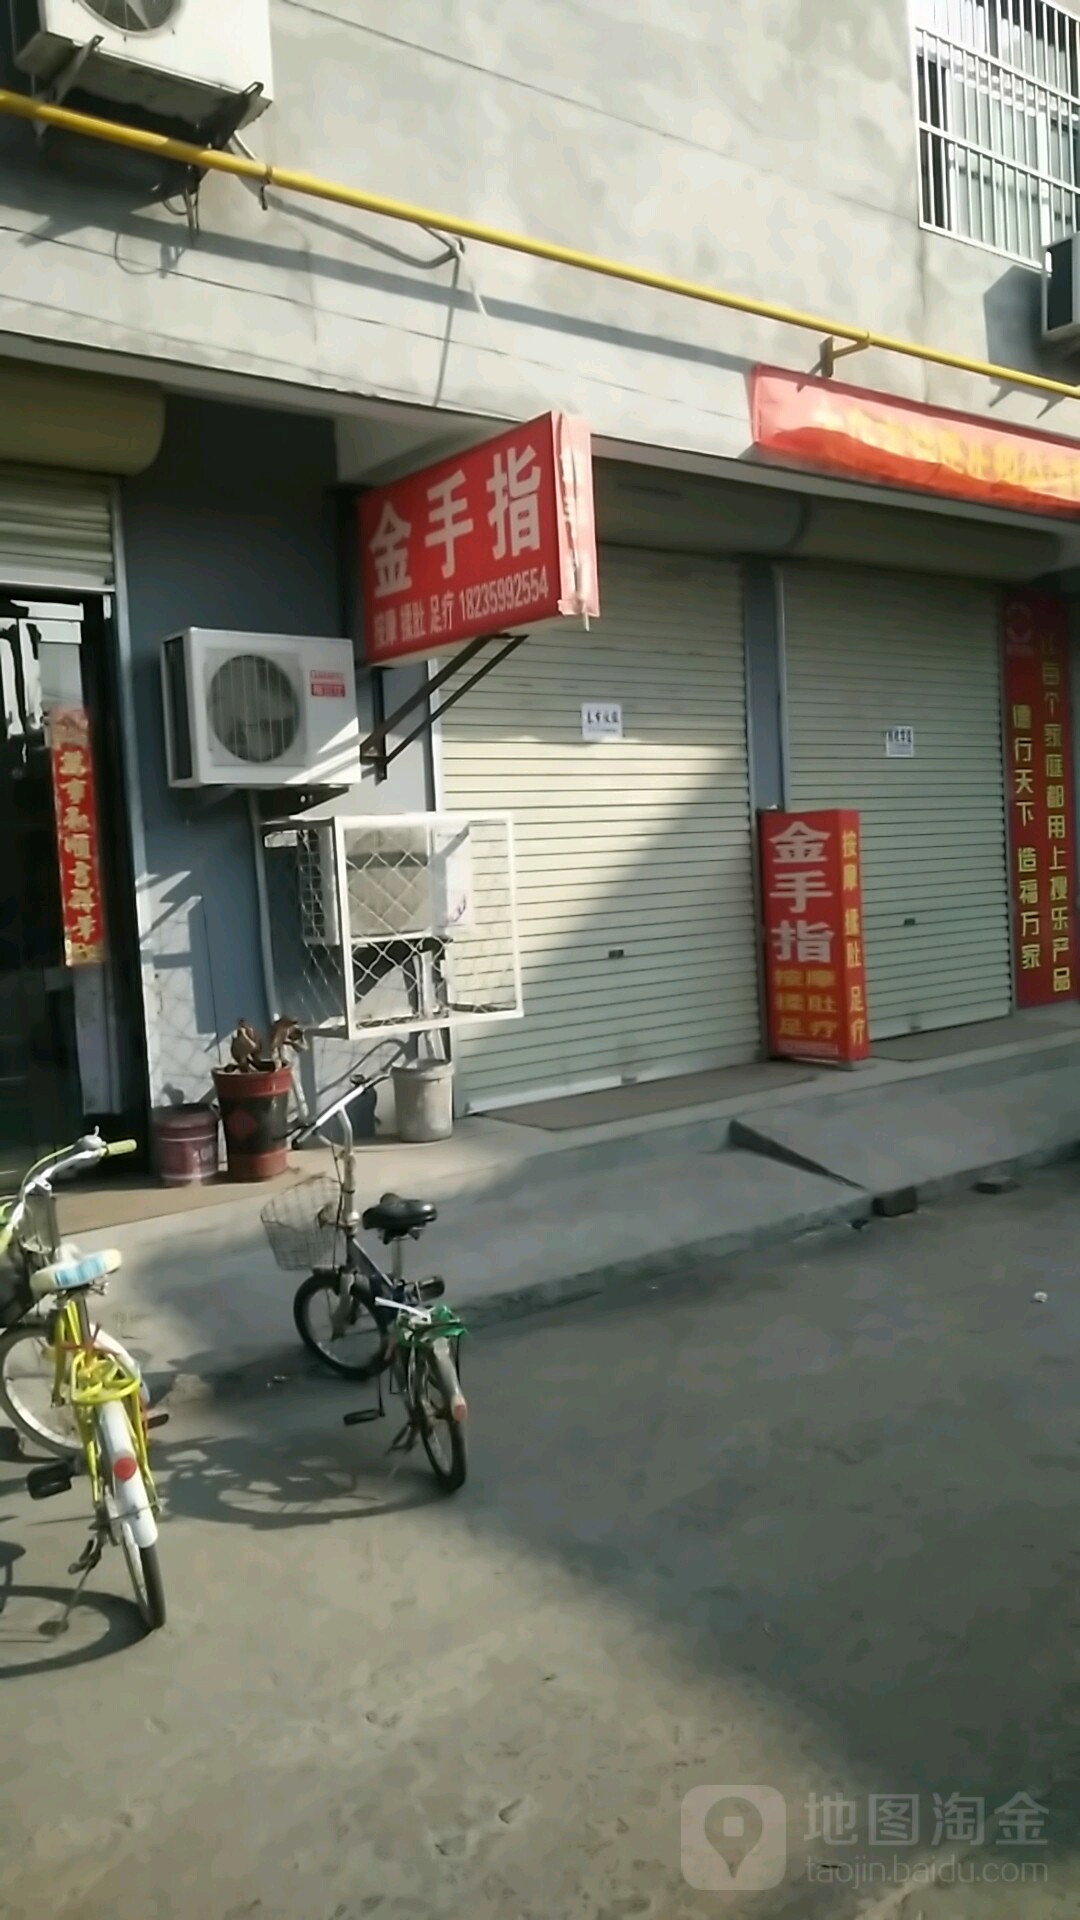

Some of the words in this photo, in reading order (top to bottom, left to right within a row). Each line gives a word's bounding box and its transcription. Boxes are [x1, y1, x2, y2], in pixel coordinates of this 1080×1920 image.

[369, 445, 542, 598] 金手指
[430, 591, 454, 633] 足疗
[460, 567, 549, 620] 18235992554
[769, 821, 834, 963] 金手指
[1017, 847, 1041, 970] 造福万家
[779, 1018, 838, 1038] 足疗
[850, 986, 865, 1045] 足疗
